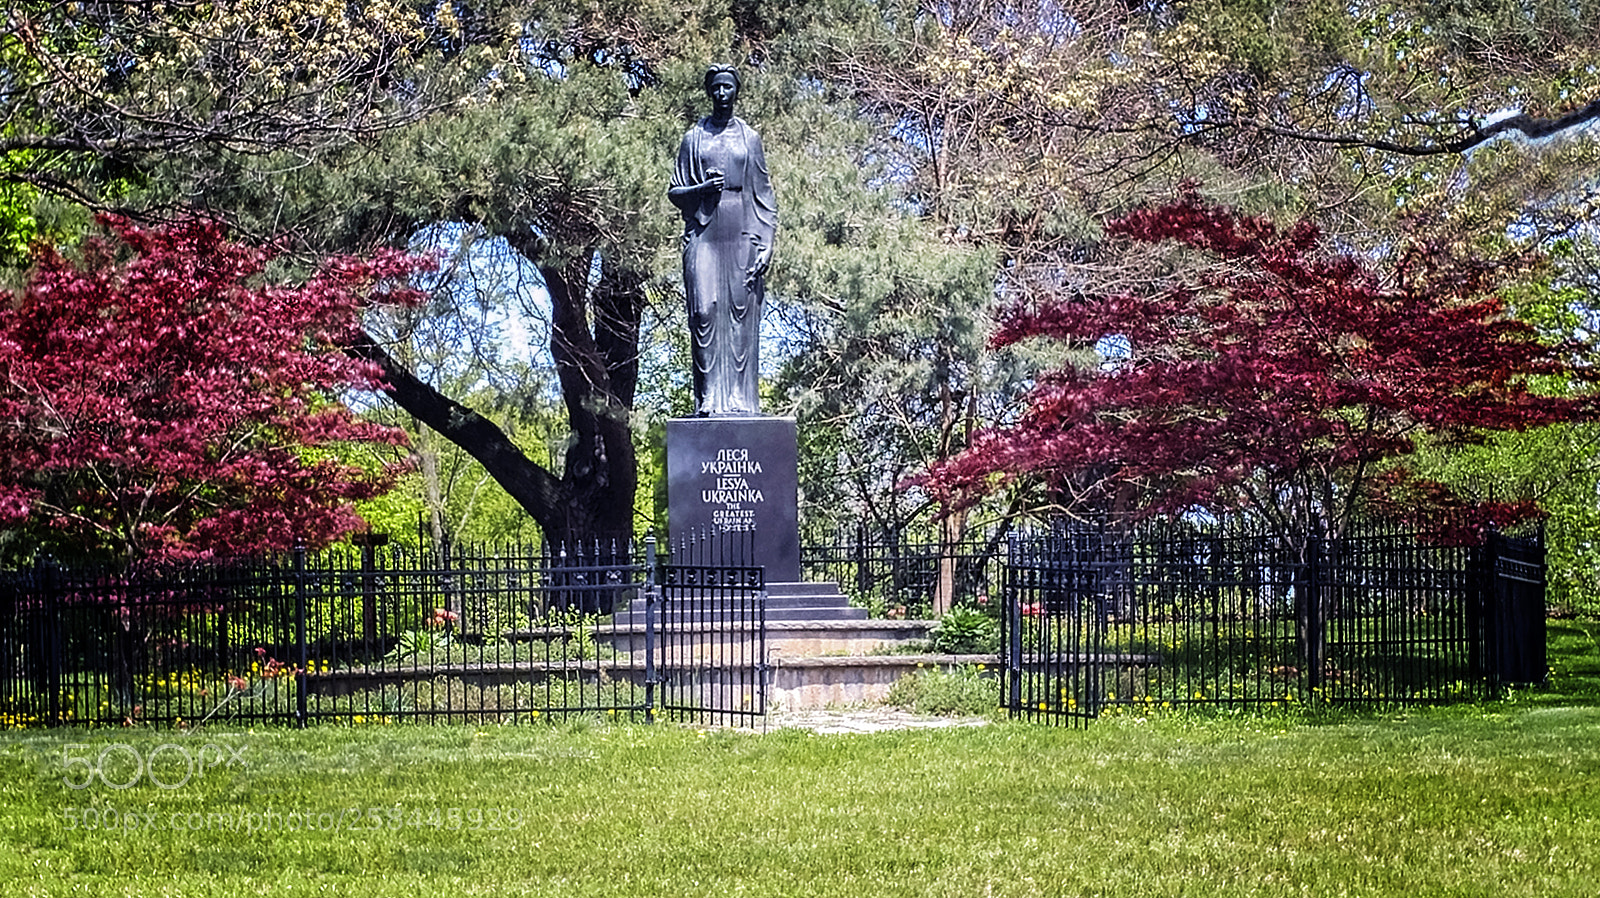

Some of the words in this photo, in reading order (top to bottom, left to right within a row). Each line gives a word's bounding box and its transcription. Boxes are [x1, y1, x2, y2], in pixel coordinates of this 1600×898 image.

[716, 449, 749, 461] ЛЕСЯ
[717, 477, 749, 490] LESYA
[702, 490, 764, 503] UKRAINKA
[726, 502, 741, 510] THE
[713, 510, 755, 518] GREATEST
